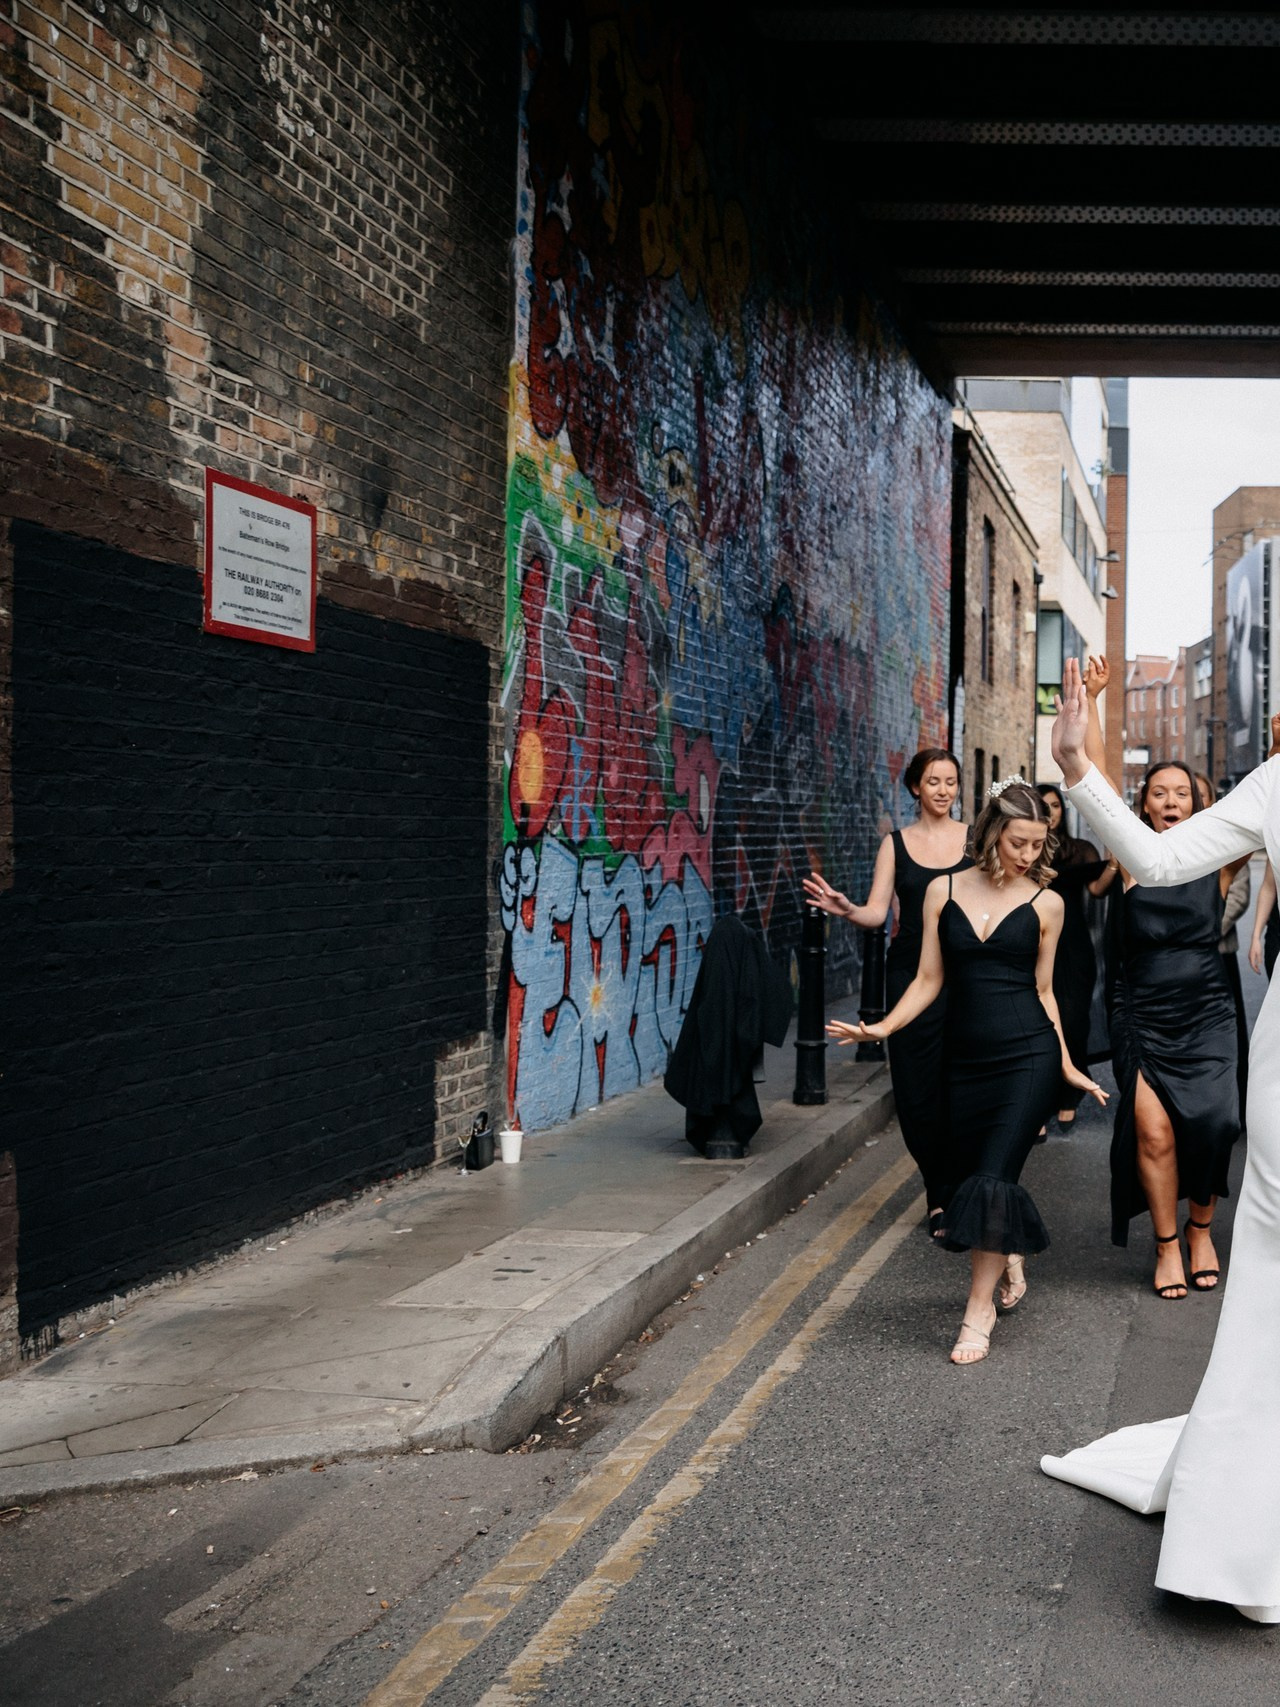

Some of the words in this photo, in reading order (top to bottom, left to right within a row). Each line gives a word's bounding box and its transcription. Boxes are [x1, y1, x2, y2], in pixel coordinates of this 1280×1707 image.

[239, 506, 250, 517] THIS
[251, 511, 256, 519] IS
[256, 512, 274, 525] BRIDGE
[275, 541, 290, 553] Bridge
[224, 567, 236, 579] THE
[237, 570, 264, 585] RAILWAY
[265, 579, 295, 595] AUTHORITY
[295, 588, 302, 597] on
